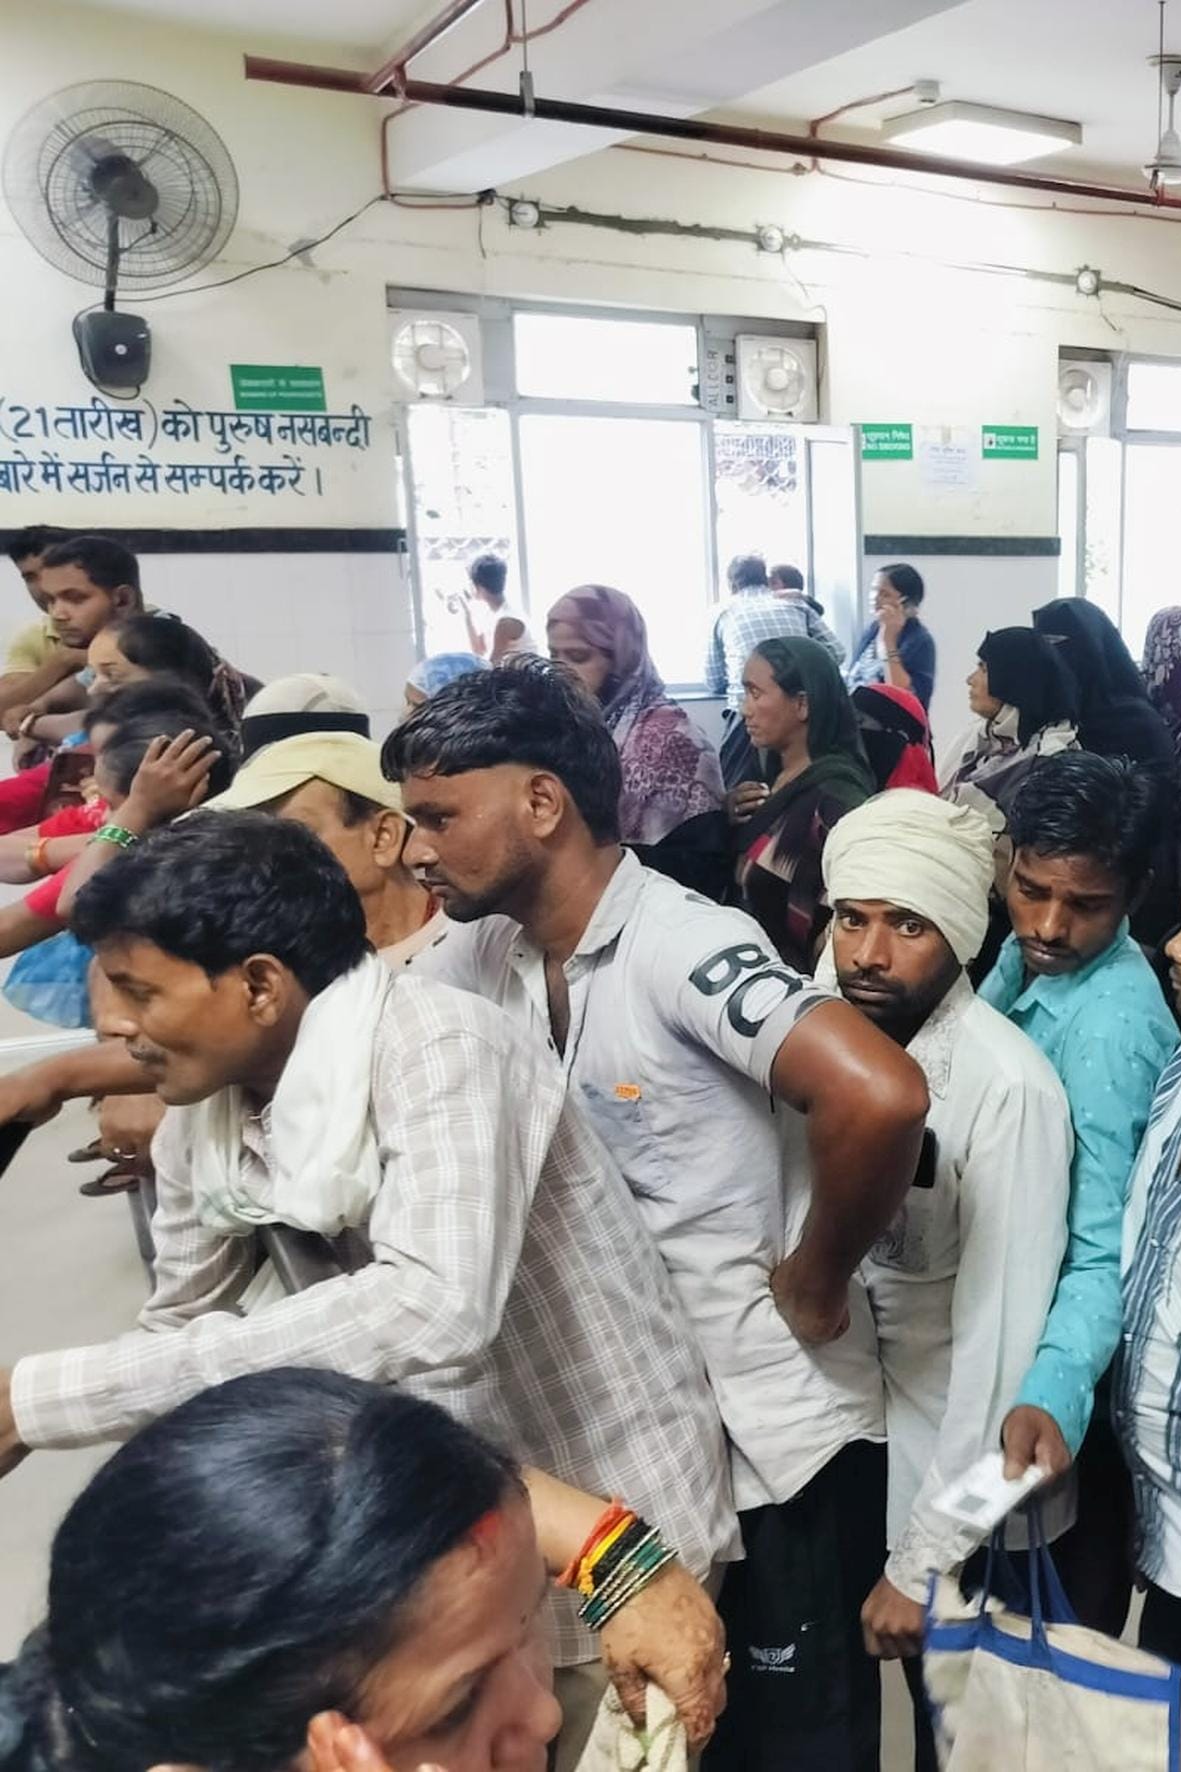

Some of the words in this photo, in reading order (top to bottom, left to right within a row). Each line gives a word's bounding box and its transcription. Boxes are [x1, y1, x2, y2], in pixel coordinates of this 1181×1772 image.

[161, 399, 203, 442] को
[278, 404, 372, 450] नसबन्दी
[39, 451, 64, 492] में
[67, 451, 131, 493] सर्जन
[135, 454, 161, 493] से
